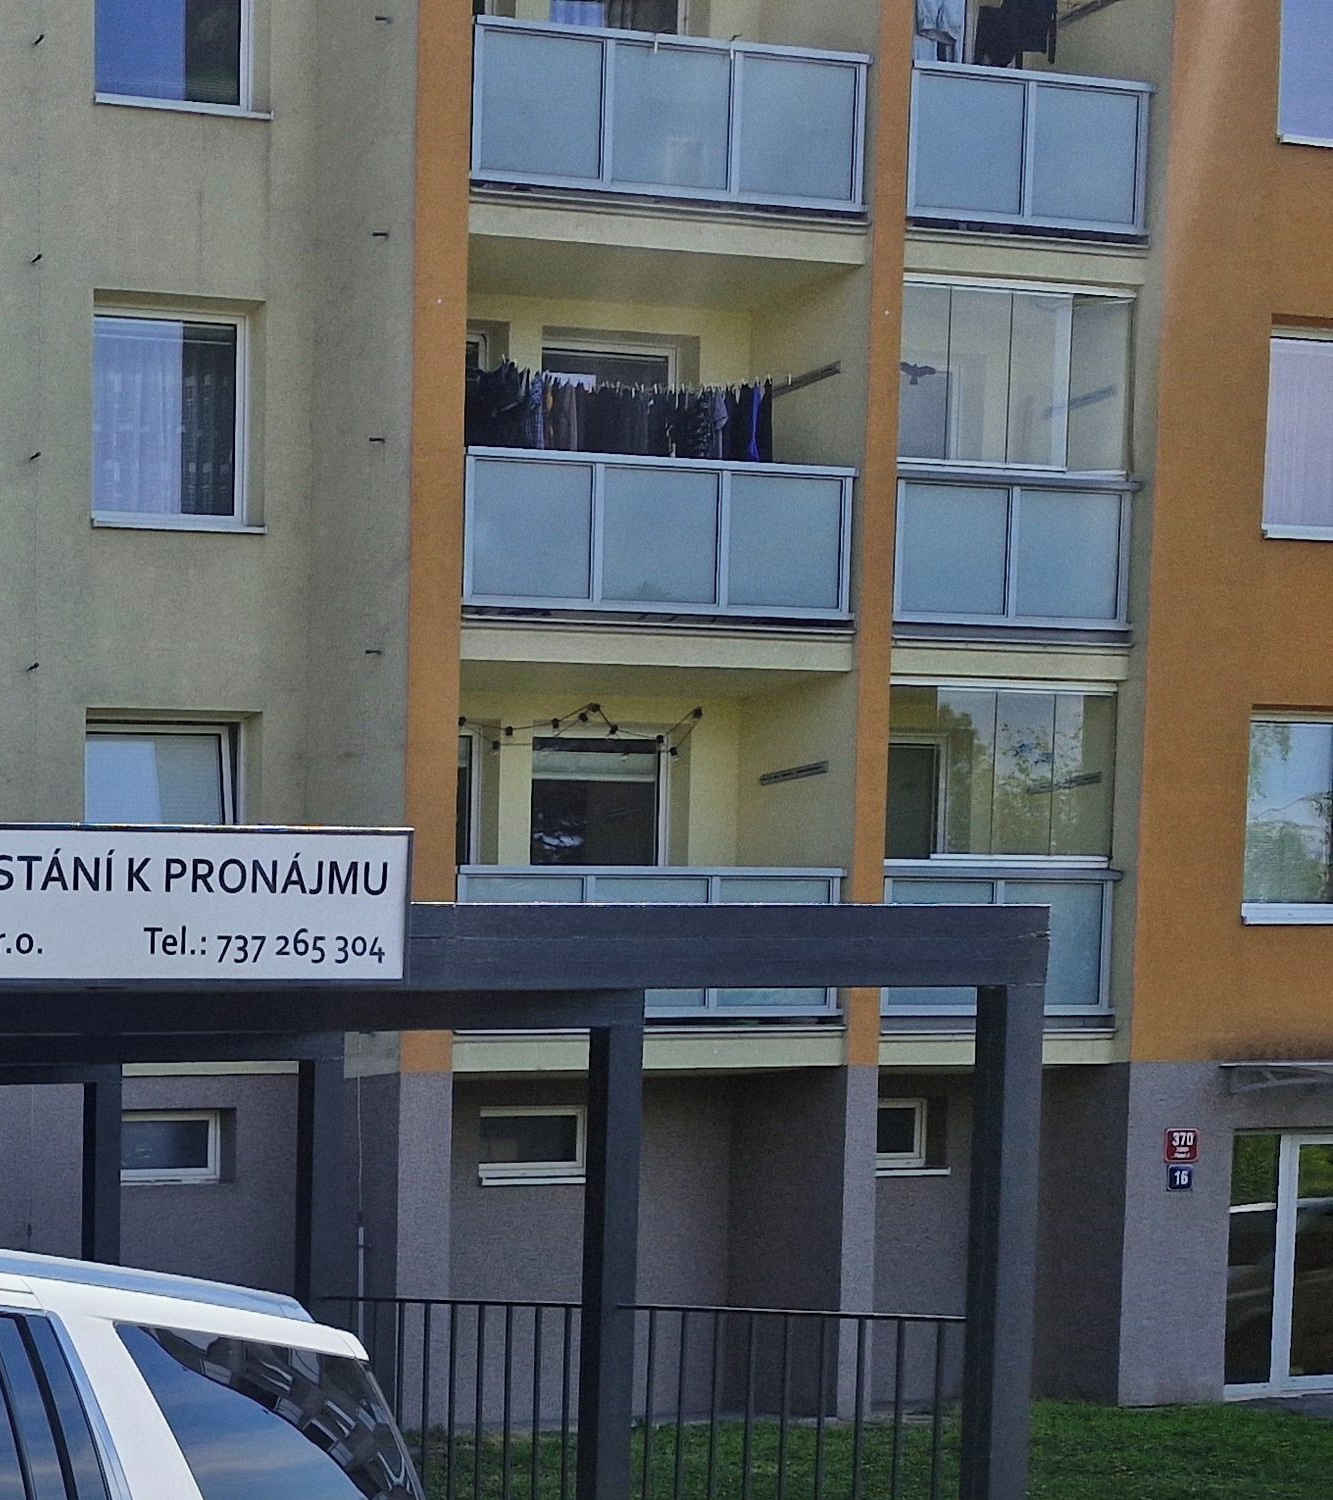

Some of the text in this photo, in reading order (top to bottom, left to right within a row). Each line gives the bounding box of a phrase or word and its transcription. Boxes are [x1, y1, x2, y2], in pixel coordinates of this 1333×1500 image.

[127, 857, 151, 893] K
[164, 852, 389, 896] PRONÁJMU
[143, 925, 385, 964] Tel.: 737 265 304
[1172, 1131, 1194, 1146] 370
[1174, 1170, 1189, 1185] 16
